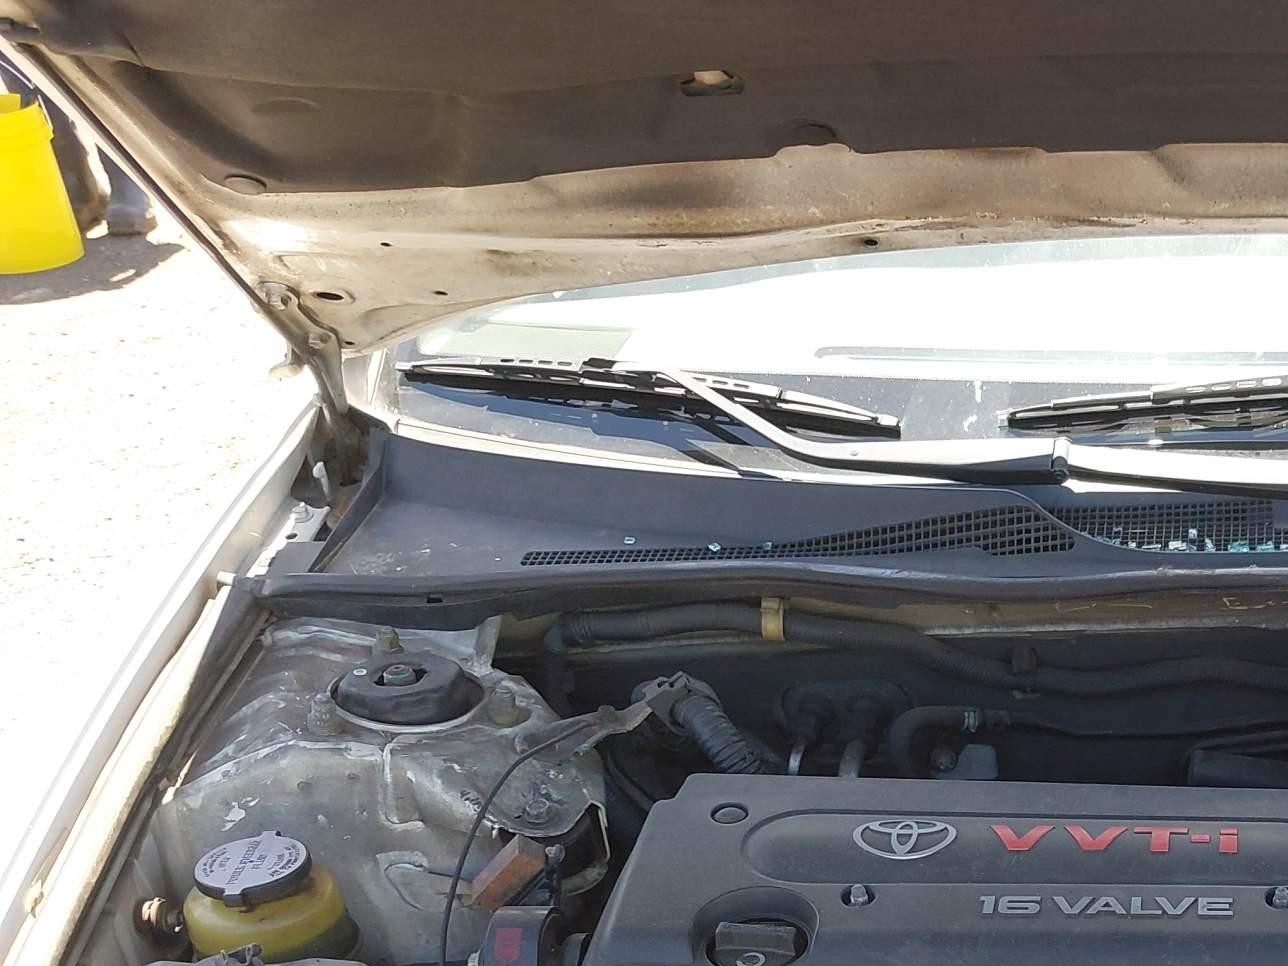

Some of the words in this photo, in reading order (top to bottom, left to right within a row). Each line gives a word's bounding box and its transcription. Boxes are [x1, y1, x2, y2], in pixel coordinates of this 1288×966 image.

[990, 824, 1239, 854] VVT-i
[979, 895, 1041, 915] 16
[1052, 895, 1235, 917] VALVE
